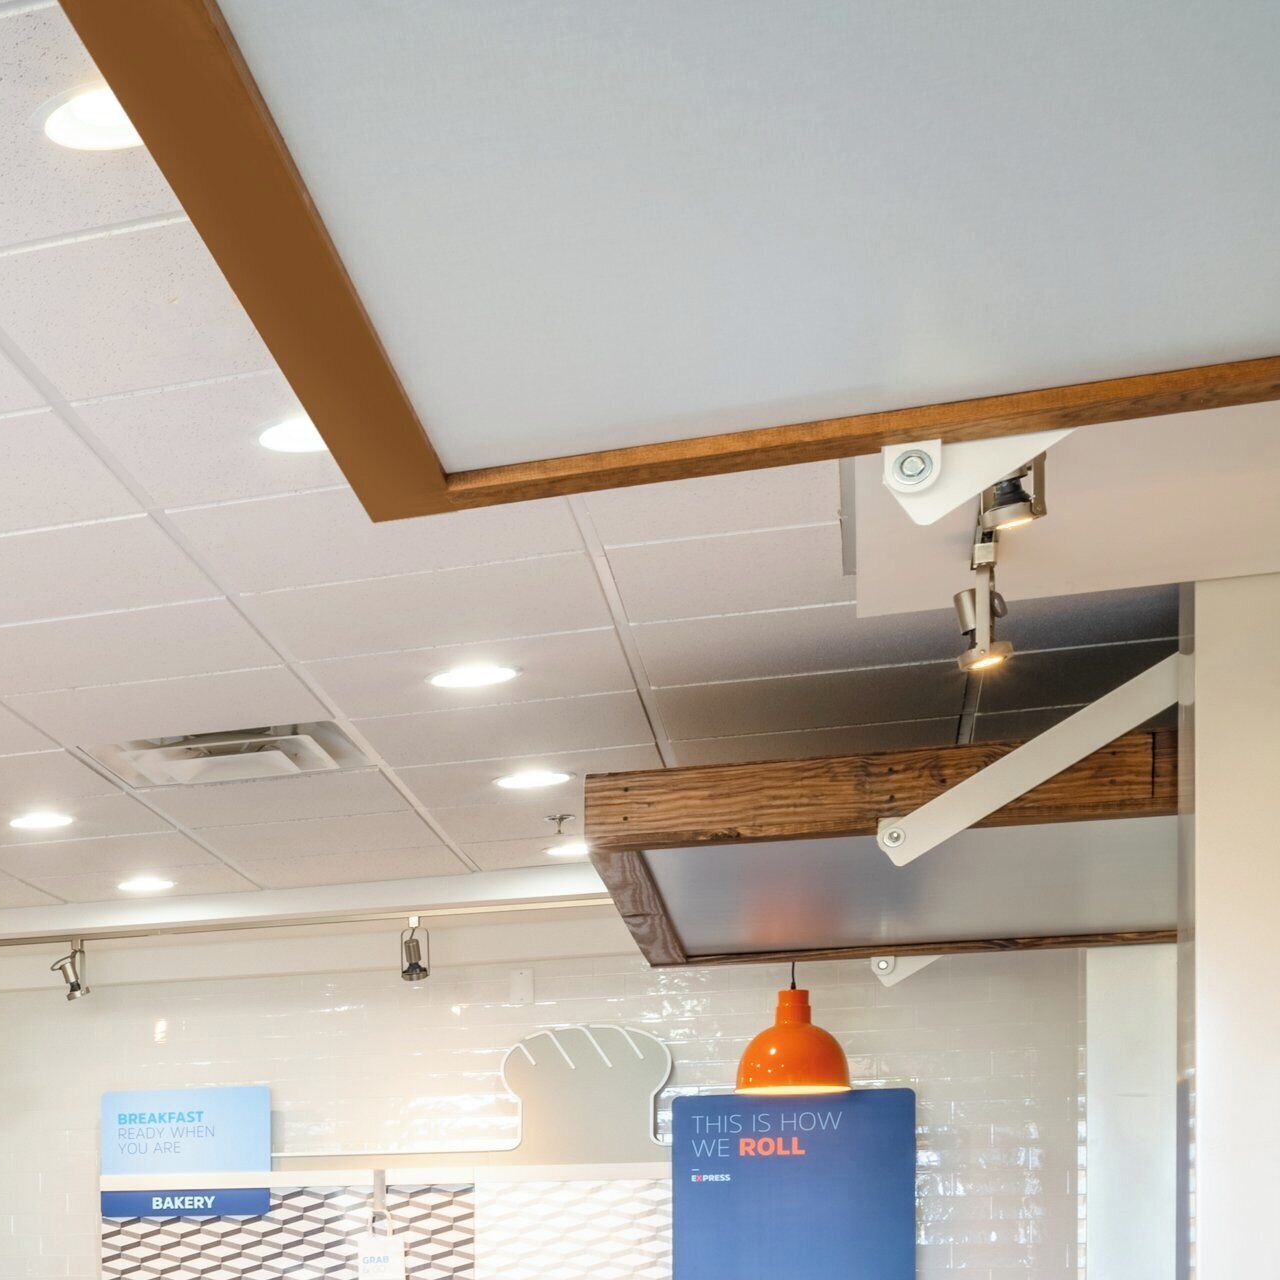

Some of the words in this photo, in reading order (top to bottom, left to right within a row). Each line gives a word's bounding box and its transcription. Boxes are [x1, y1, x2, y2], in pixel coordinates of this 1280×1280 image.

[117, 1110, 204, 1125] BREAKFAST
[691, 1114, 743, 1134] THIS
[752, 1113, 771, 1133] IS
[781, 1111, 843, 1131] HOW
[118, 1127, 164, 1140] READY
[171, 1125, 215, 1138] WHEN
[118, 1142, 148, 1155] YOU
[153, 1141, 181, 1154] ARE
[691, 1138, 730, 1158] WE
[739, 1136, 806, 1156] ROLL
[691, 1174, 731, 1182] EXPRESS
[152, 1195, 215, 1210] BAKERY
